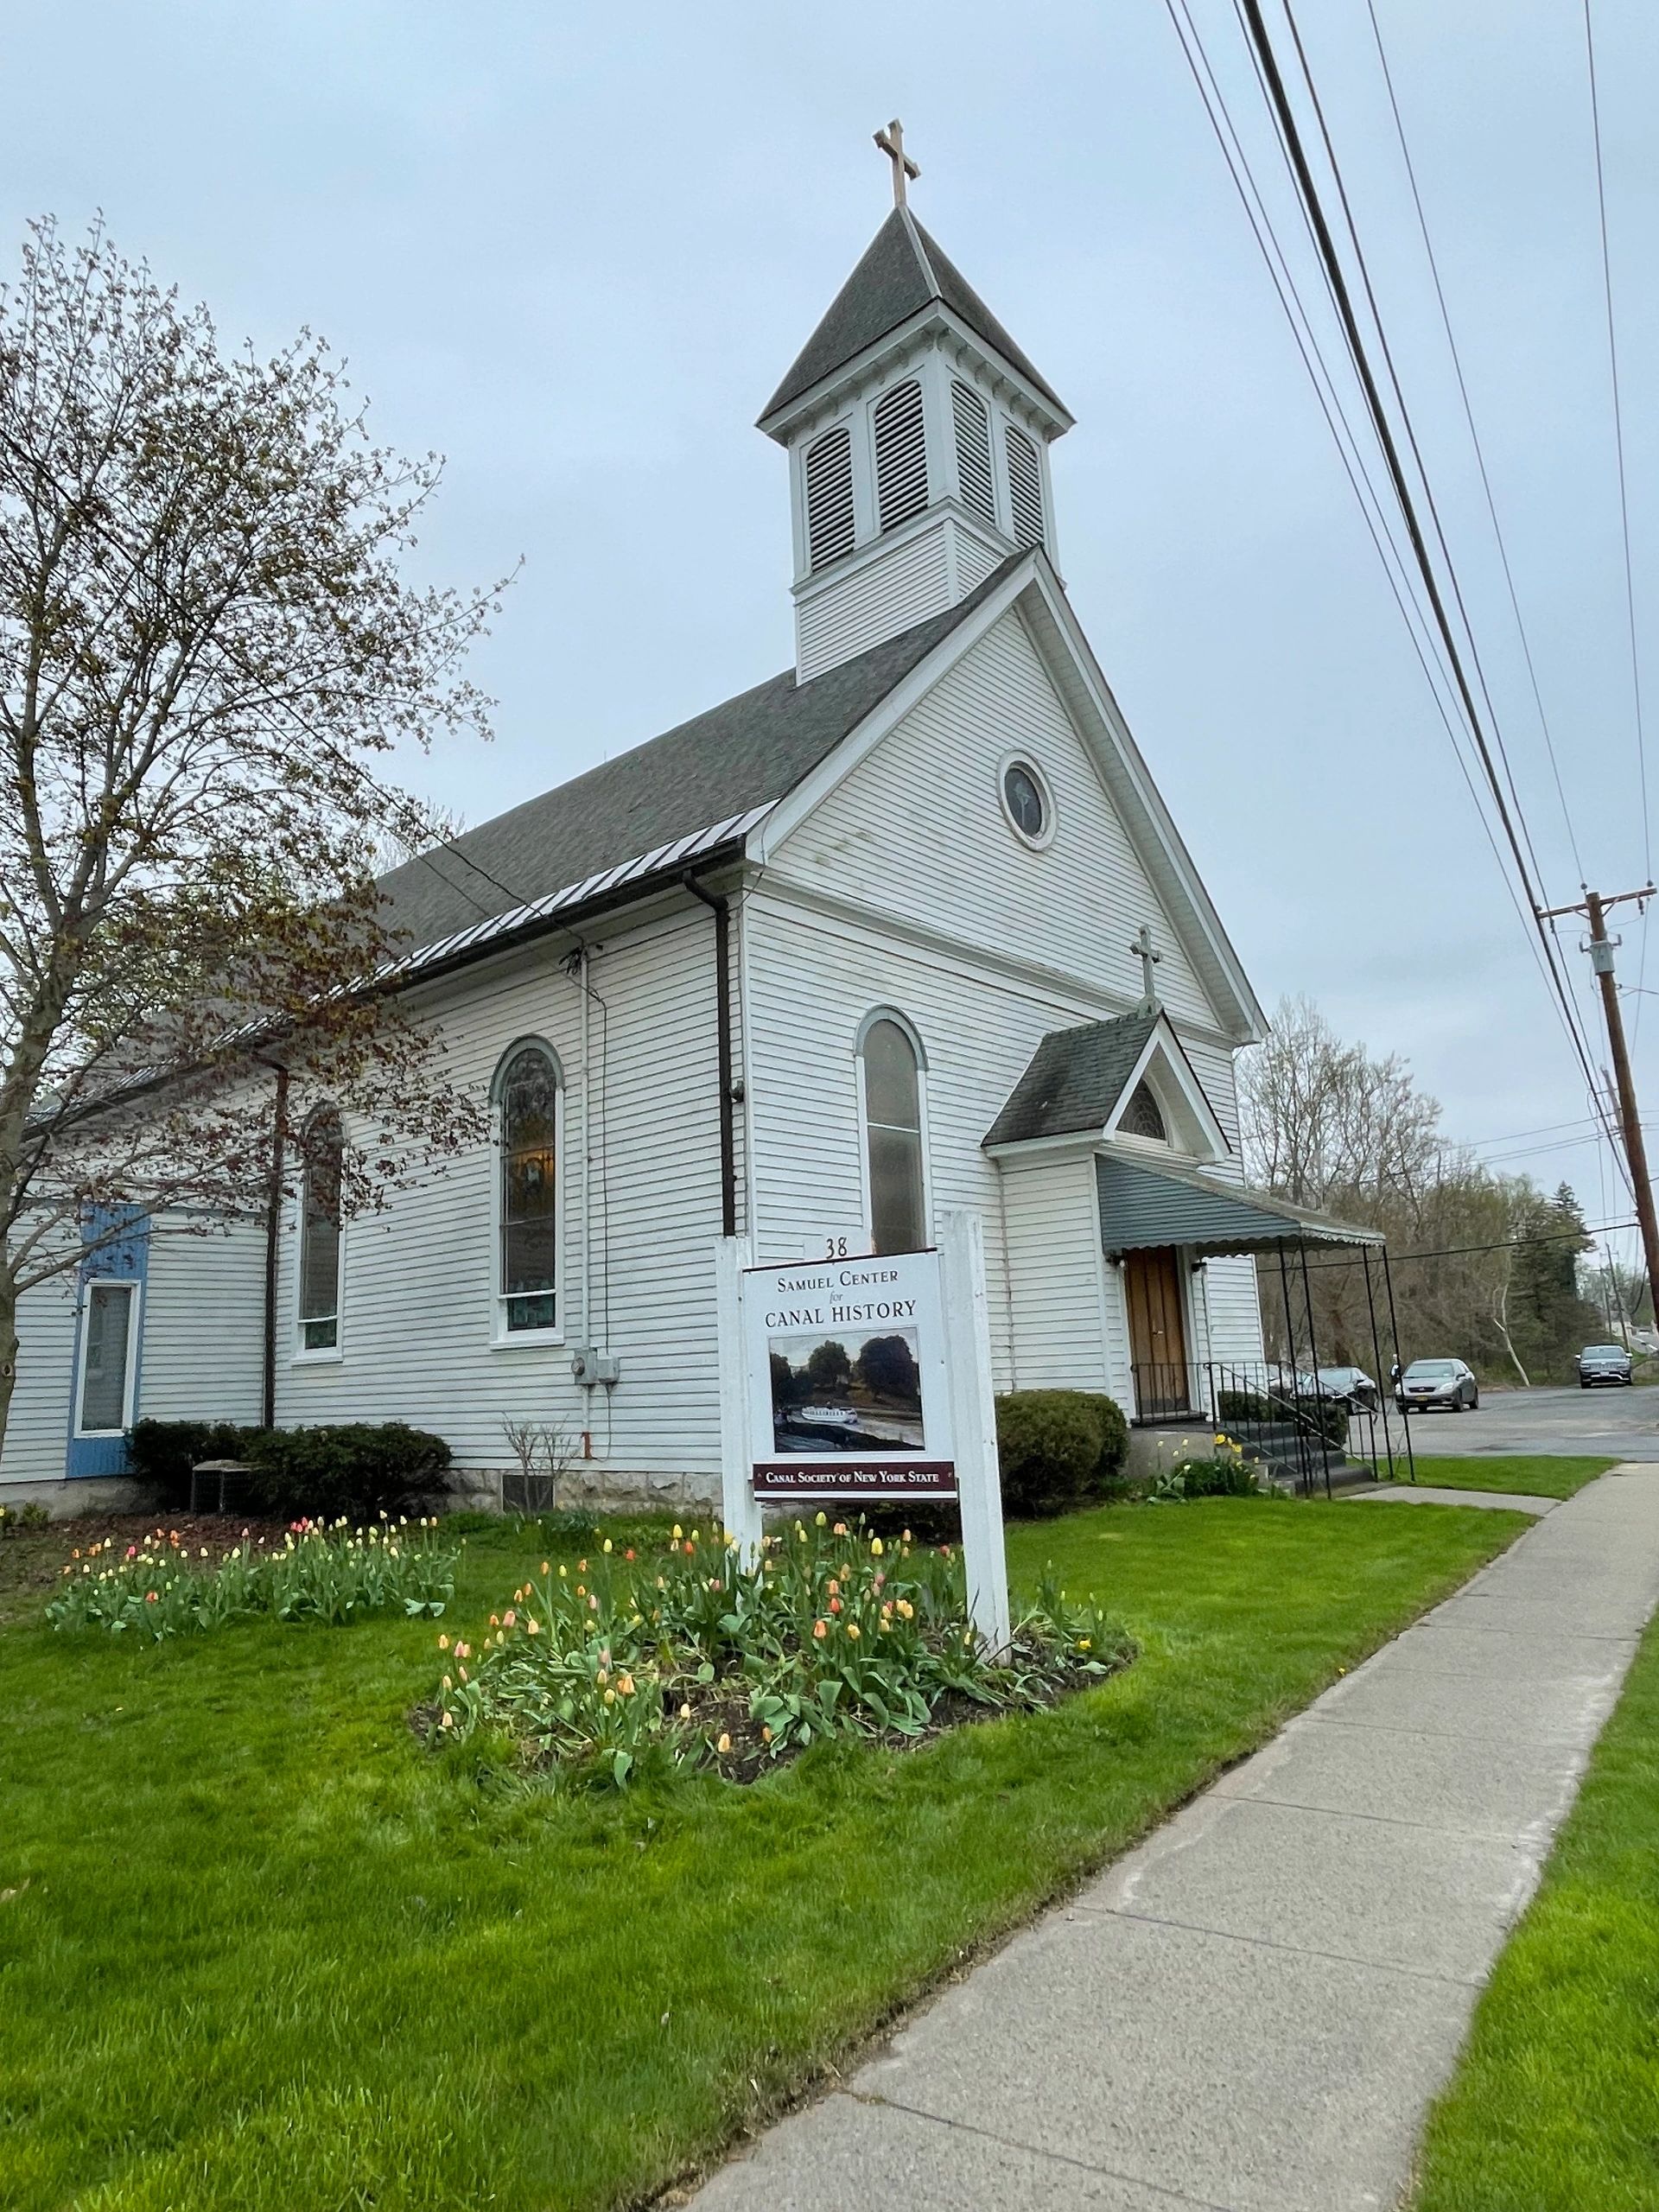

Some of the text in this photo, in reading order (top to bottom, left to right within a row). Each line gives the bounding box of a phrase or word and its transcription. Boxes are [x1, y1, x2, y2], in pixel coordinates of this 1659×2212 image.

[826, 1236, 848, 1260] 38
[830, 1290, 843, 1304] for
[766, 1300, 917, 1328] CANAL HISTORY
